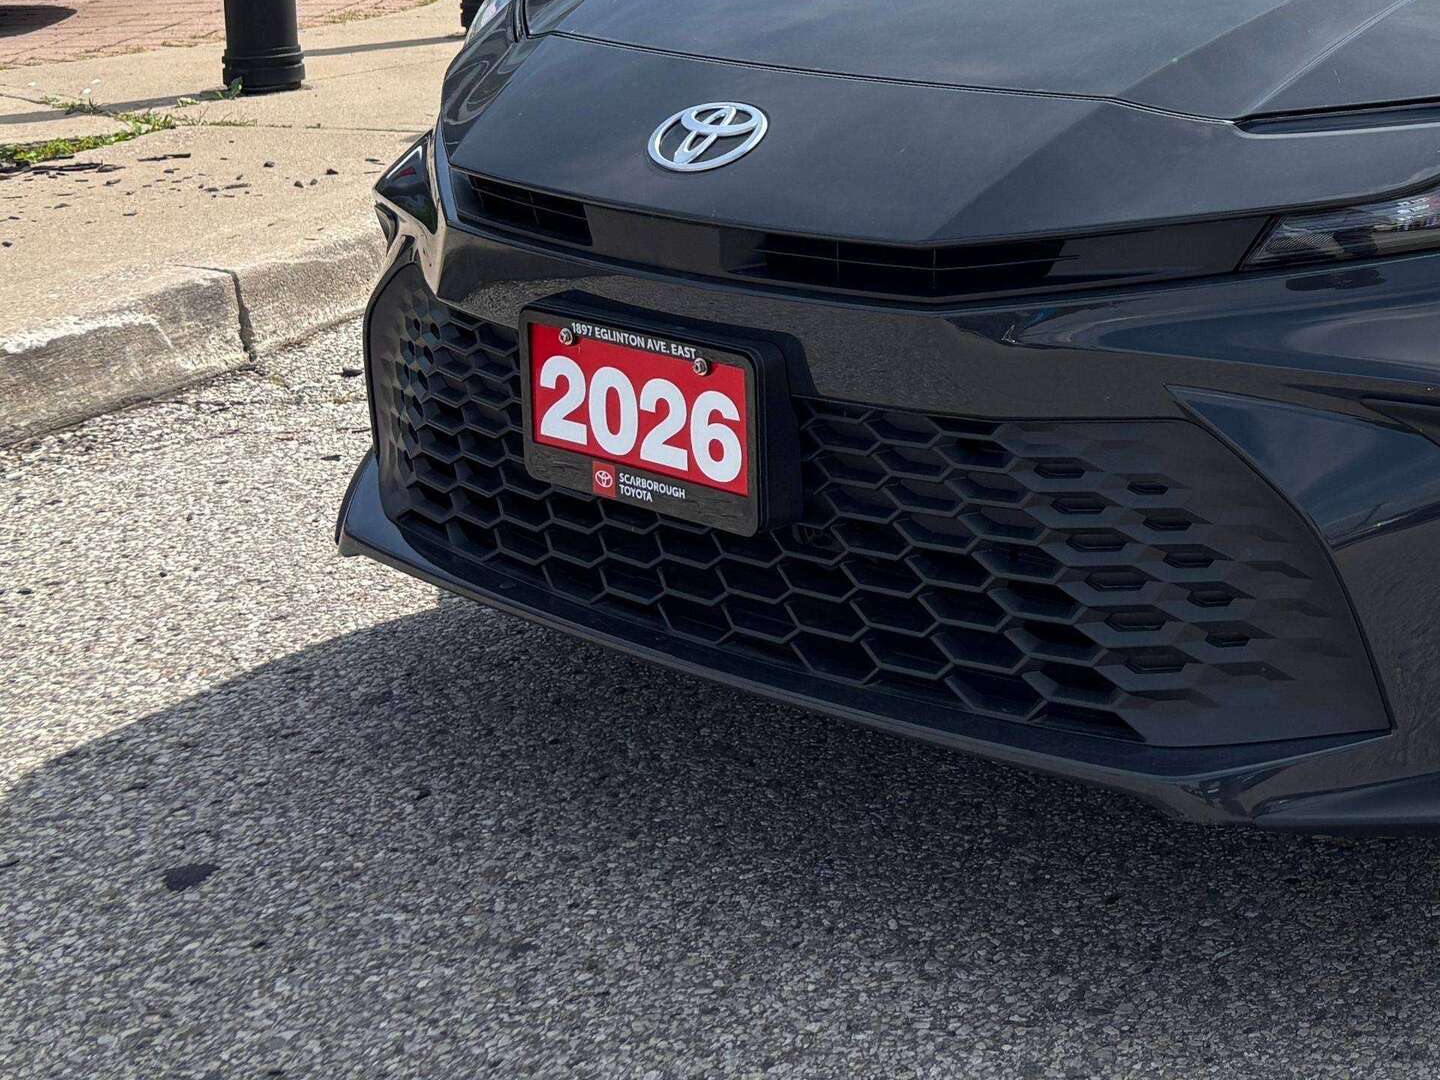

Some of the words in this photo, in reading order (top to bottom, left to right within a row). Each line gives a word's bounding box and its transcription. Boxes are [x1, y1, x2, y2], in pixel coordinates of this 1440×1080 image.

[571, 322, 593, 338] 1897
[594, 327, 645, 349] EGLINTON
[647, 338, 670, 354] AVE.
[671, 344, 696, 359] EAST
[539, 355, 742, 483] 2026
[619, 472, 686, 499] SCARBOROUGH
[619, 484, 653, 503] TOYOTA
